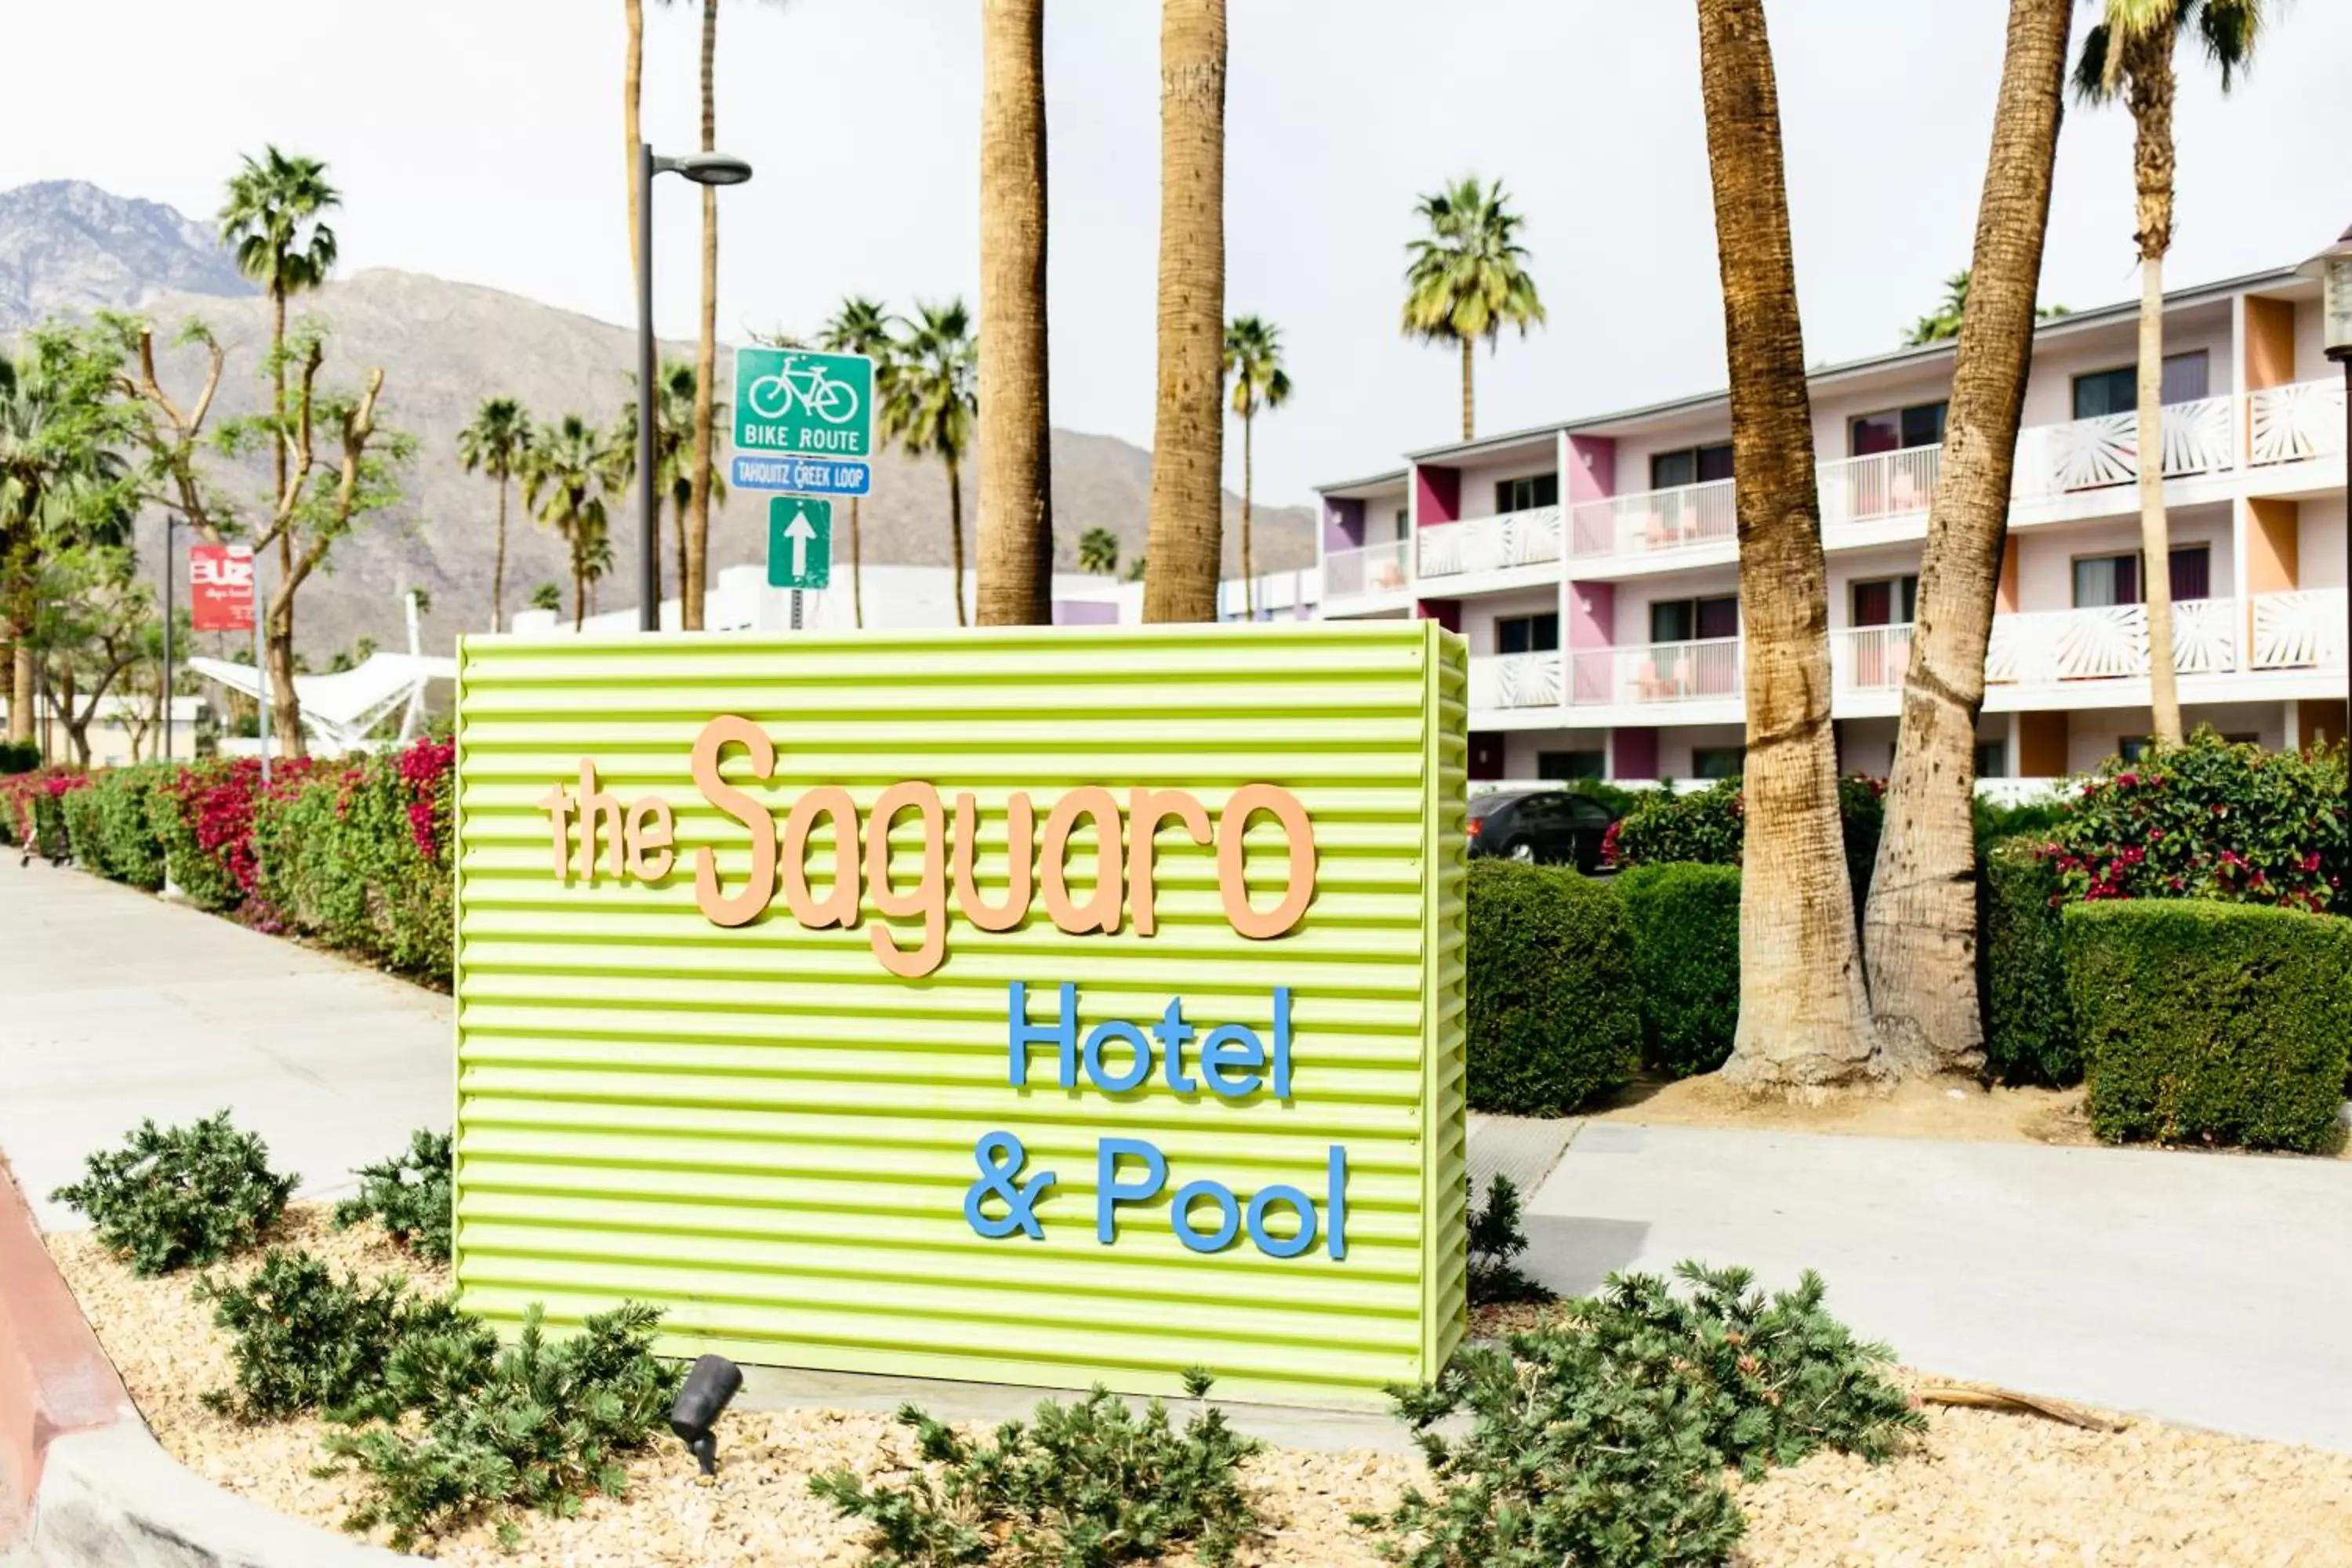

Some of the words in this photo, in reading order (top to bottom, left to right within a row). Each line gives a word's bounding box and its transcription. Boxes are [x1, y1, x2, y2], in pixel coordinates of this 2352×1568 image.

[744, 423, 789, 446] BIKE
[799, 427, 860, 452] ROUTE
[795, 464, 830, 487] CREEK
[834, 467, 864, 488] LOOP
[539, 757, 673, 881] the
[691, 714, 1316, 978] Saguaro
[1008, 981, 1291, 1098] Hotel
[964, 1131, 1056, 1240] &
[1097, 1137, 1346, 1261] Pool
